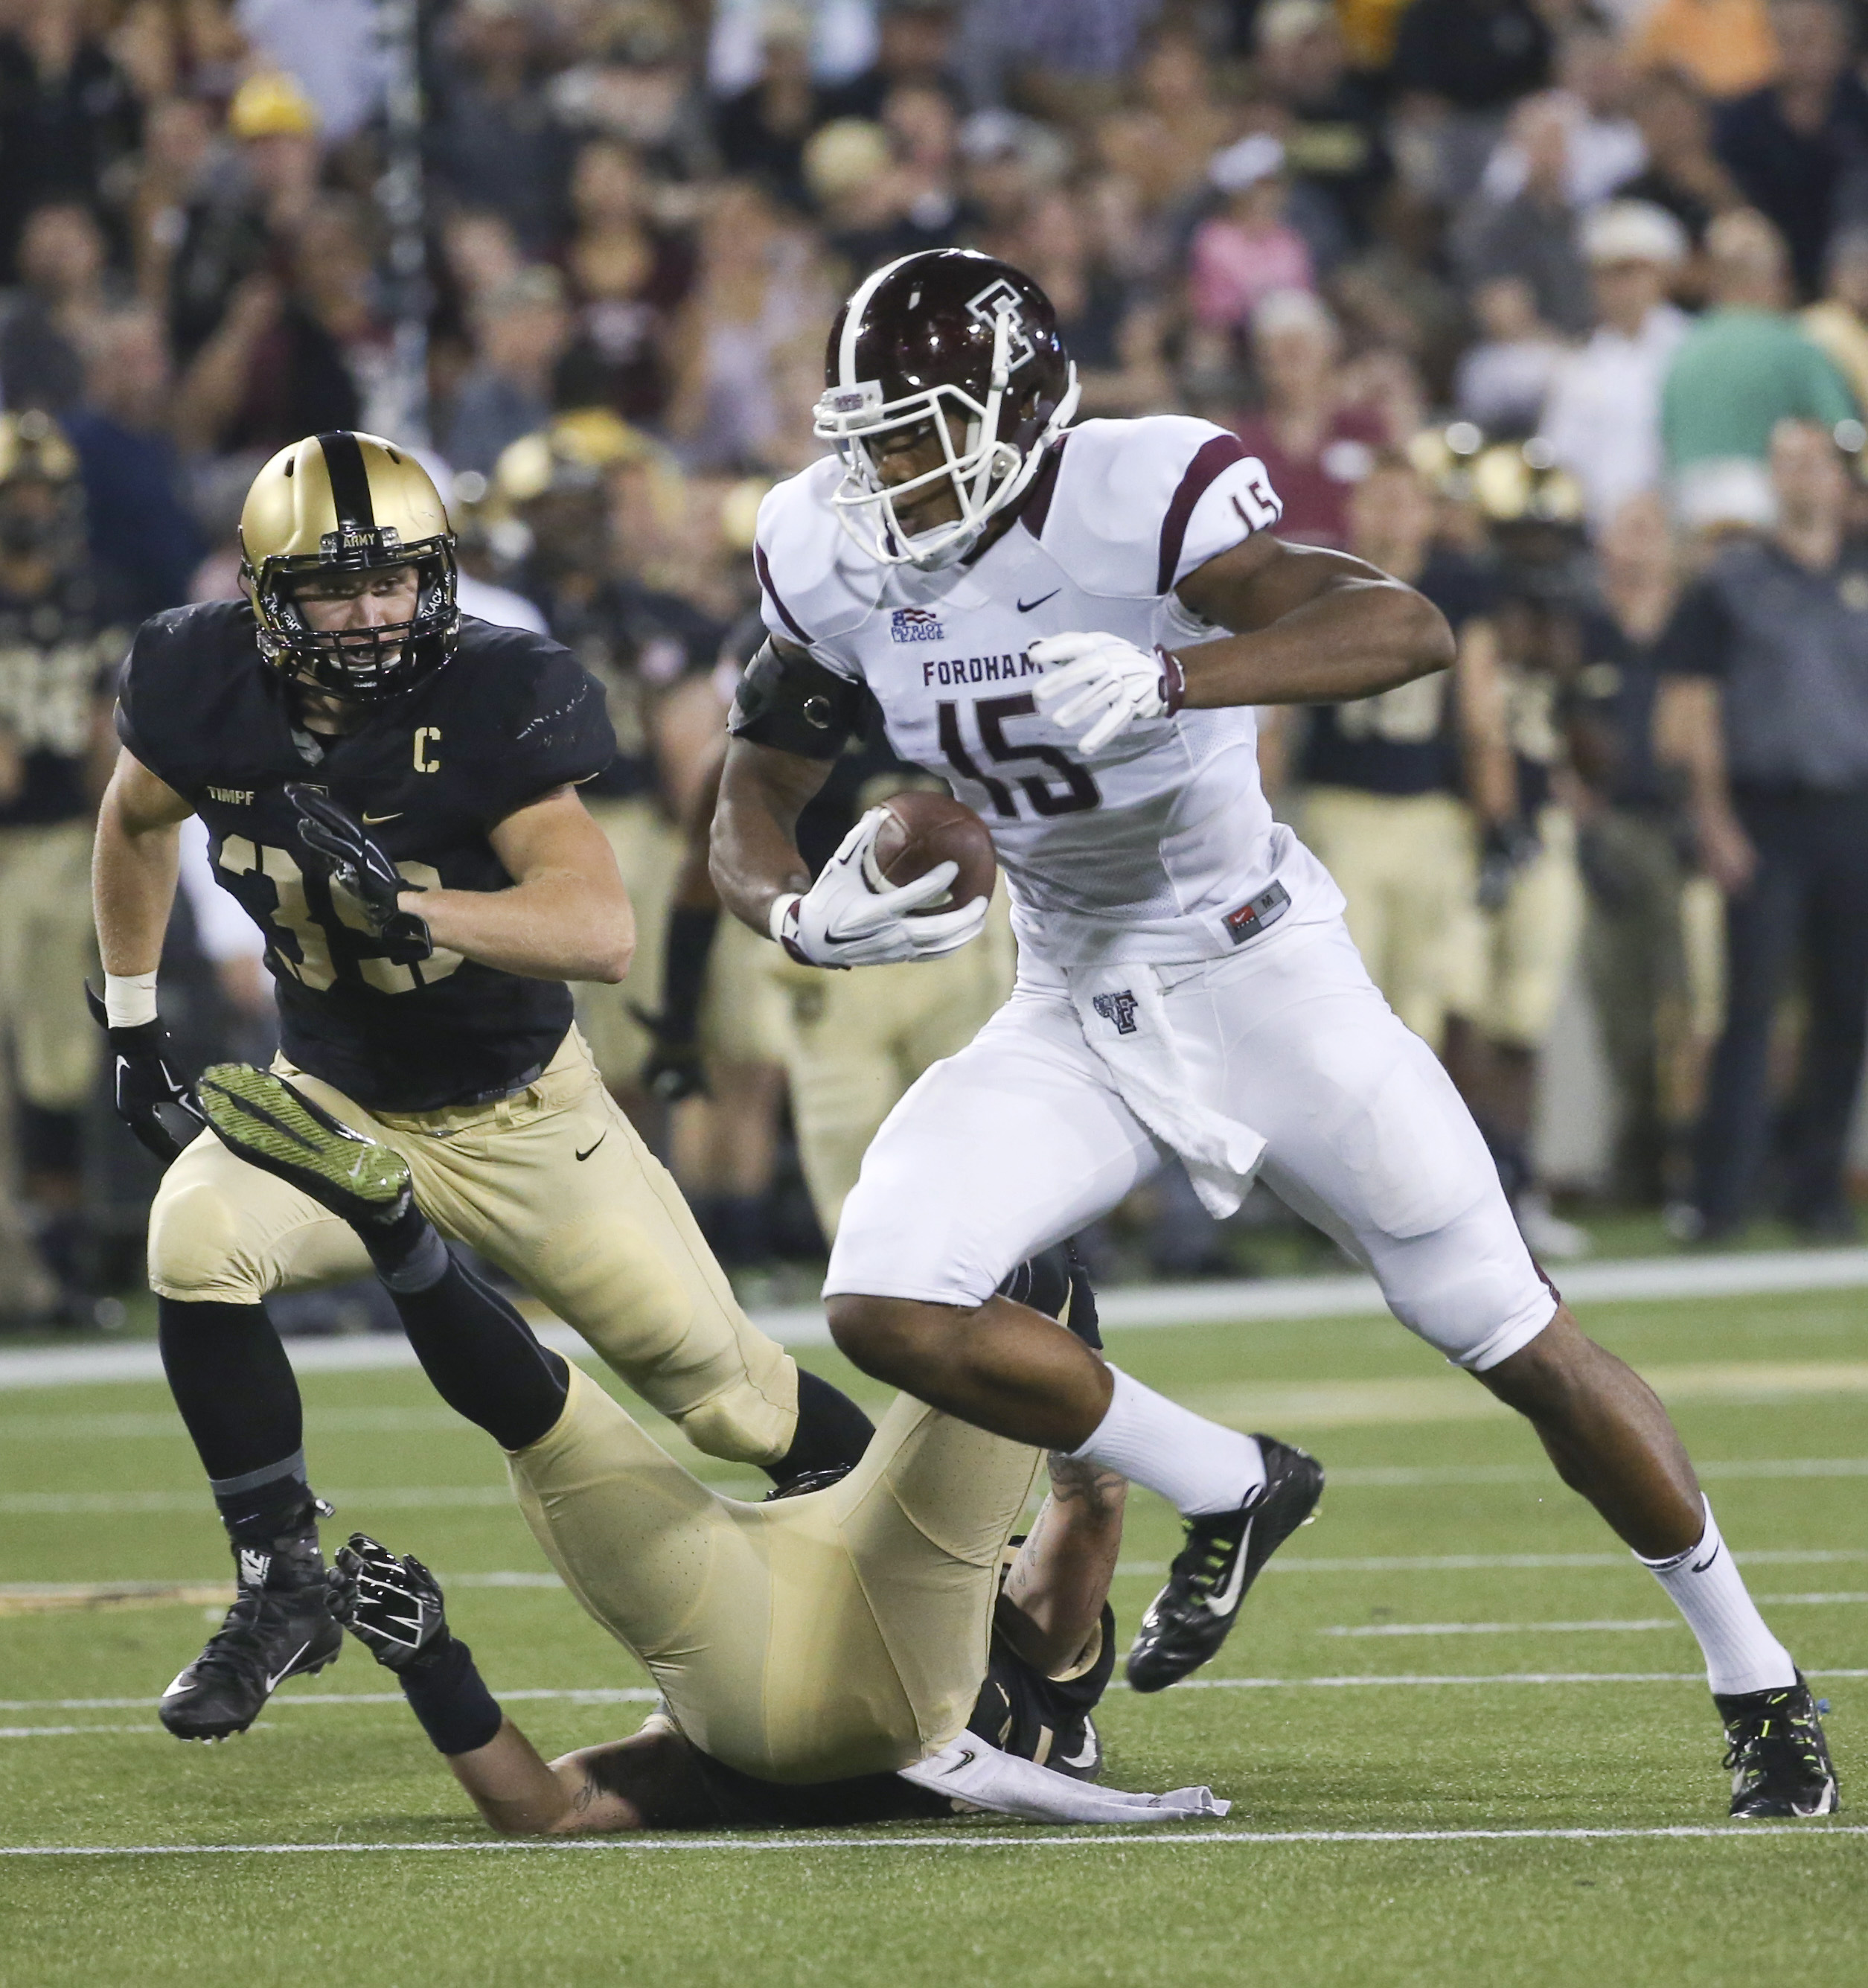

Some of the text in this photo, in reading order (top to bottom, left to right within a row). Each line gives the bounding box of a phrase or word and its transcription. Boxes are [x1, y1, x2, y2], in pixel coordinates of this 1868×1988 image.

[1230, 479, 1279, 533] 15
[343, 533, 375, 549] ARMY
[923, 652, 1043, 687] FORDHAM
[414, 726, 441, 773] C
[936, 689, 1103, 819] 15
[207, 785, 255, 806] TIMPF
